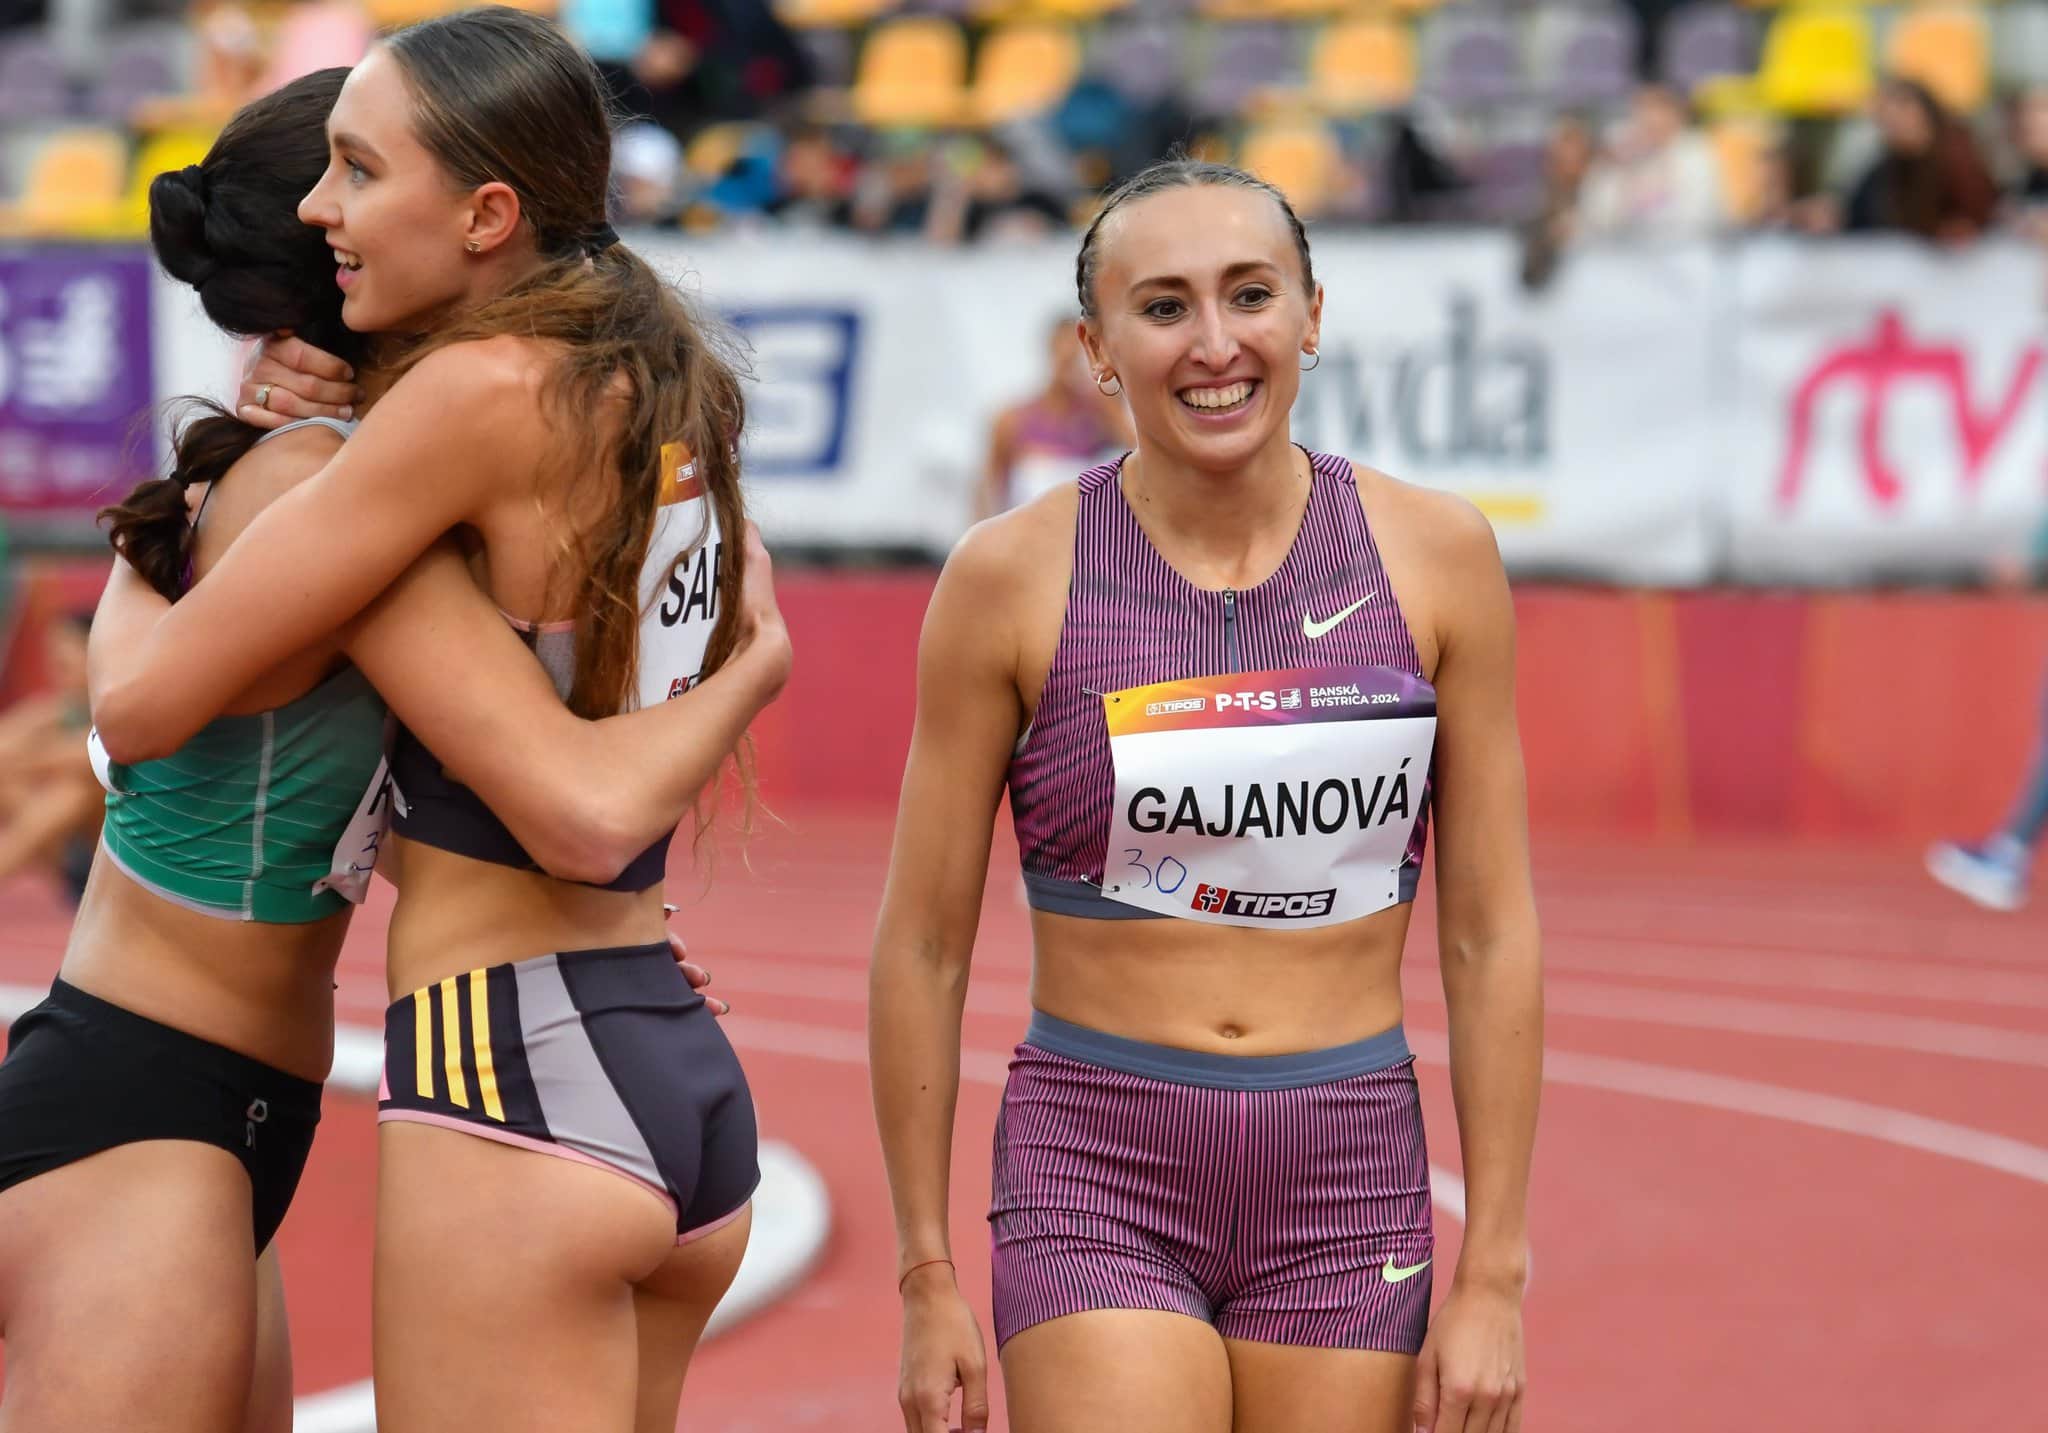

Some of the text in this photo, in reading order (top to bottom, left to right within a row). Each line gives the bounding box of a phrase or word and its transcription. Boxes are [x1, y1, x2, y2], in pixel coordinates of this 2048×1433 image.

[1162, 690, 1278, 713] TIPOS P-T-S
[1309, 683, 1360, 697] BANSKÁ
[1311, 693, 1400, 708] BYSTRICA 2024
[1127, 757, 1412, 838] GAJANOVÁ
[1124, 848, 1187, 894] 30
[1234, 892, 1331, 916] TIPOS
